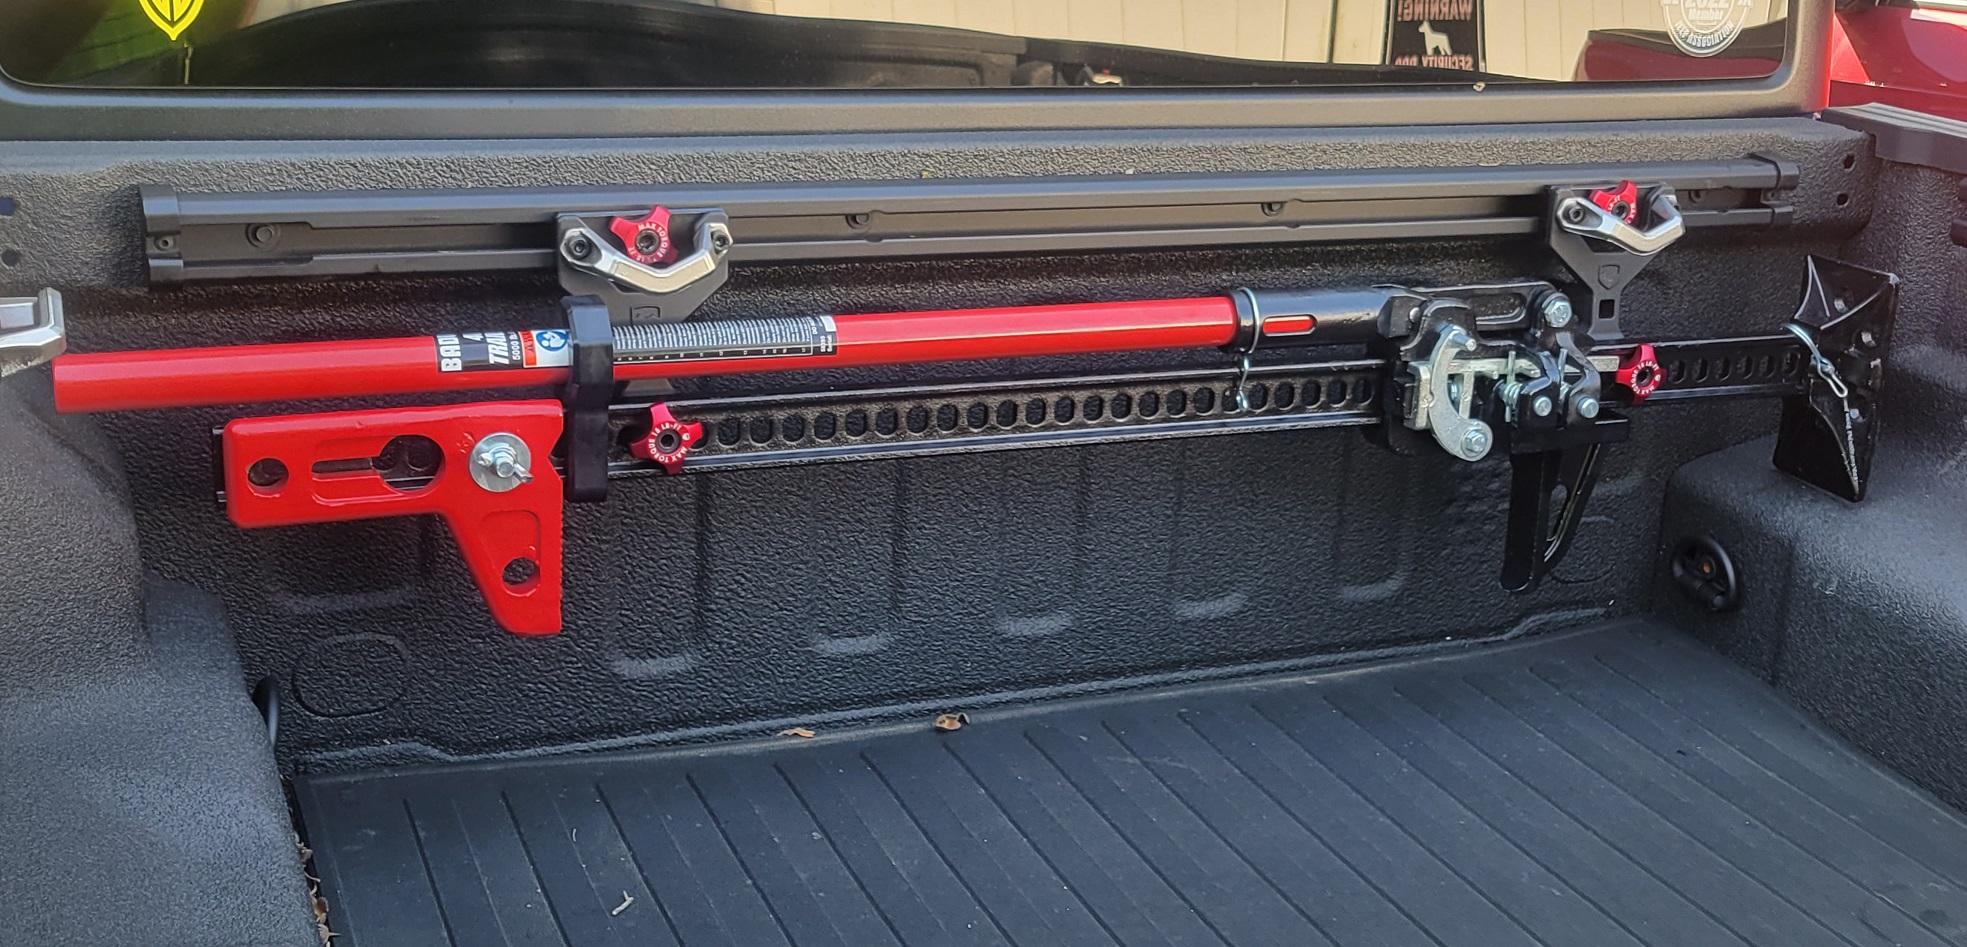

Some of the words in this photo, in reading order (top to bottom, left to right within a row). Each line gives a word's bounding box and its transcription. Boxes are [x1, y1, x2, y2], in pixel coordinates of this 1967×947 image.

[1686, 21, 1736, 47] ASSOCIATION
[637, 222, 658, 231] MAX
[657, 226, 669, 258] TORQUE
[510, 340, 521, 360] 5000
[648, 439, 669, 463] TORQUE
[671, 446, 688, 462] MAX
